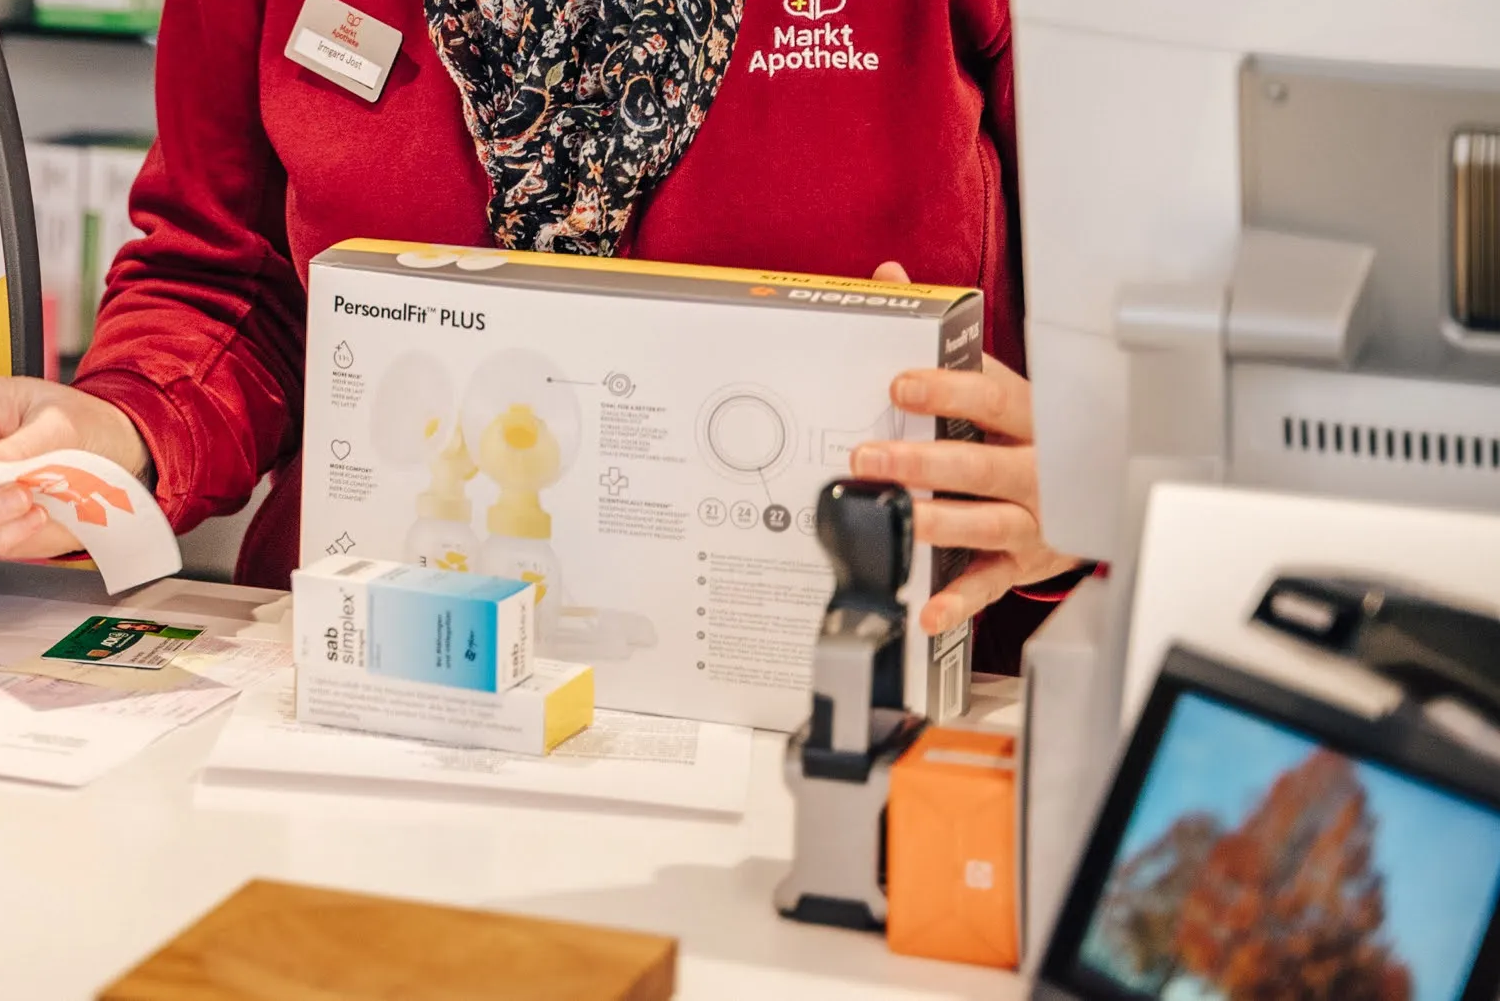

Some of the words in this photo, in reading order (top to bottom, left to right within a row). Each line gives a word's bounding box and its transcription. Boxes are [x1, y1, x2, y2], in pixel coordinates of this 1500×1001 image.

[331, 28, 359, 48] Apotheke
[339, 24, 357, 38] Markt
[773, 22, 854, 48] Markt
[317, 40, 345, 62] Irmgard
[345, 54, 363, 70] Jost
[748, 46, 879, 78] Apotheke
[788, 287, 922, 309] medela
[440, 309, 486, 331] PLUS
[705, 504, 719, 515] 21
[737, 506, 752, 517] 24
[769, 510, 785, 521] 27
[324, 626, 339, 662] sab
